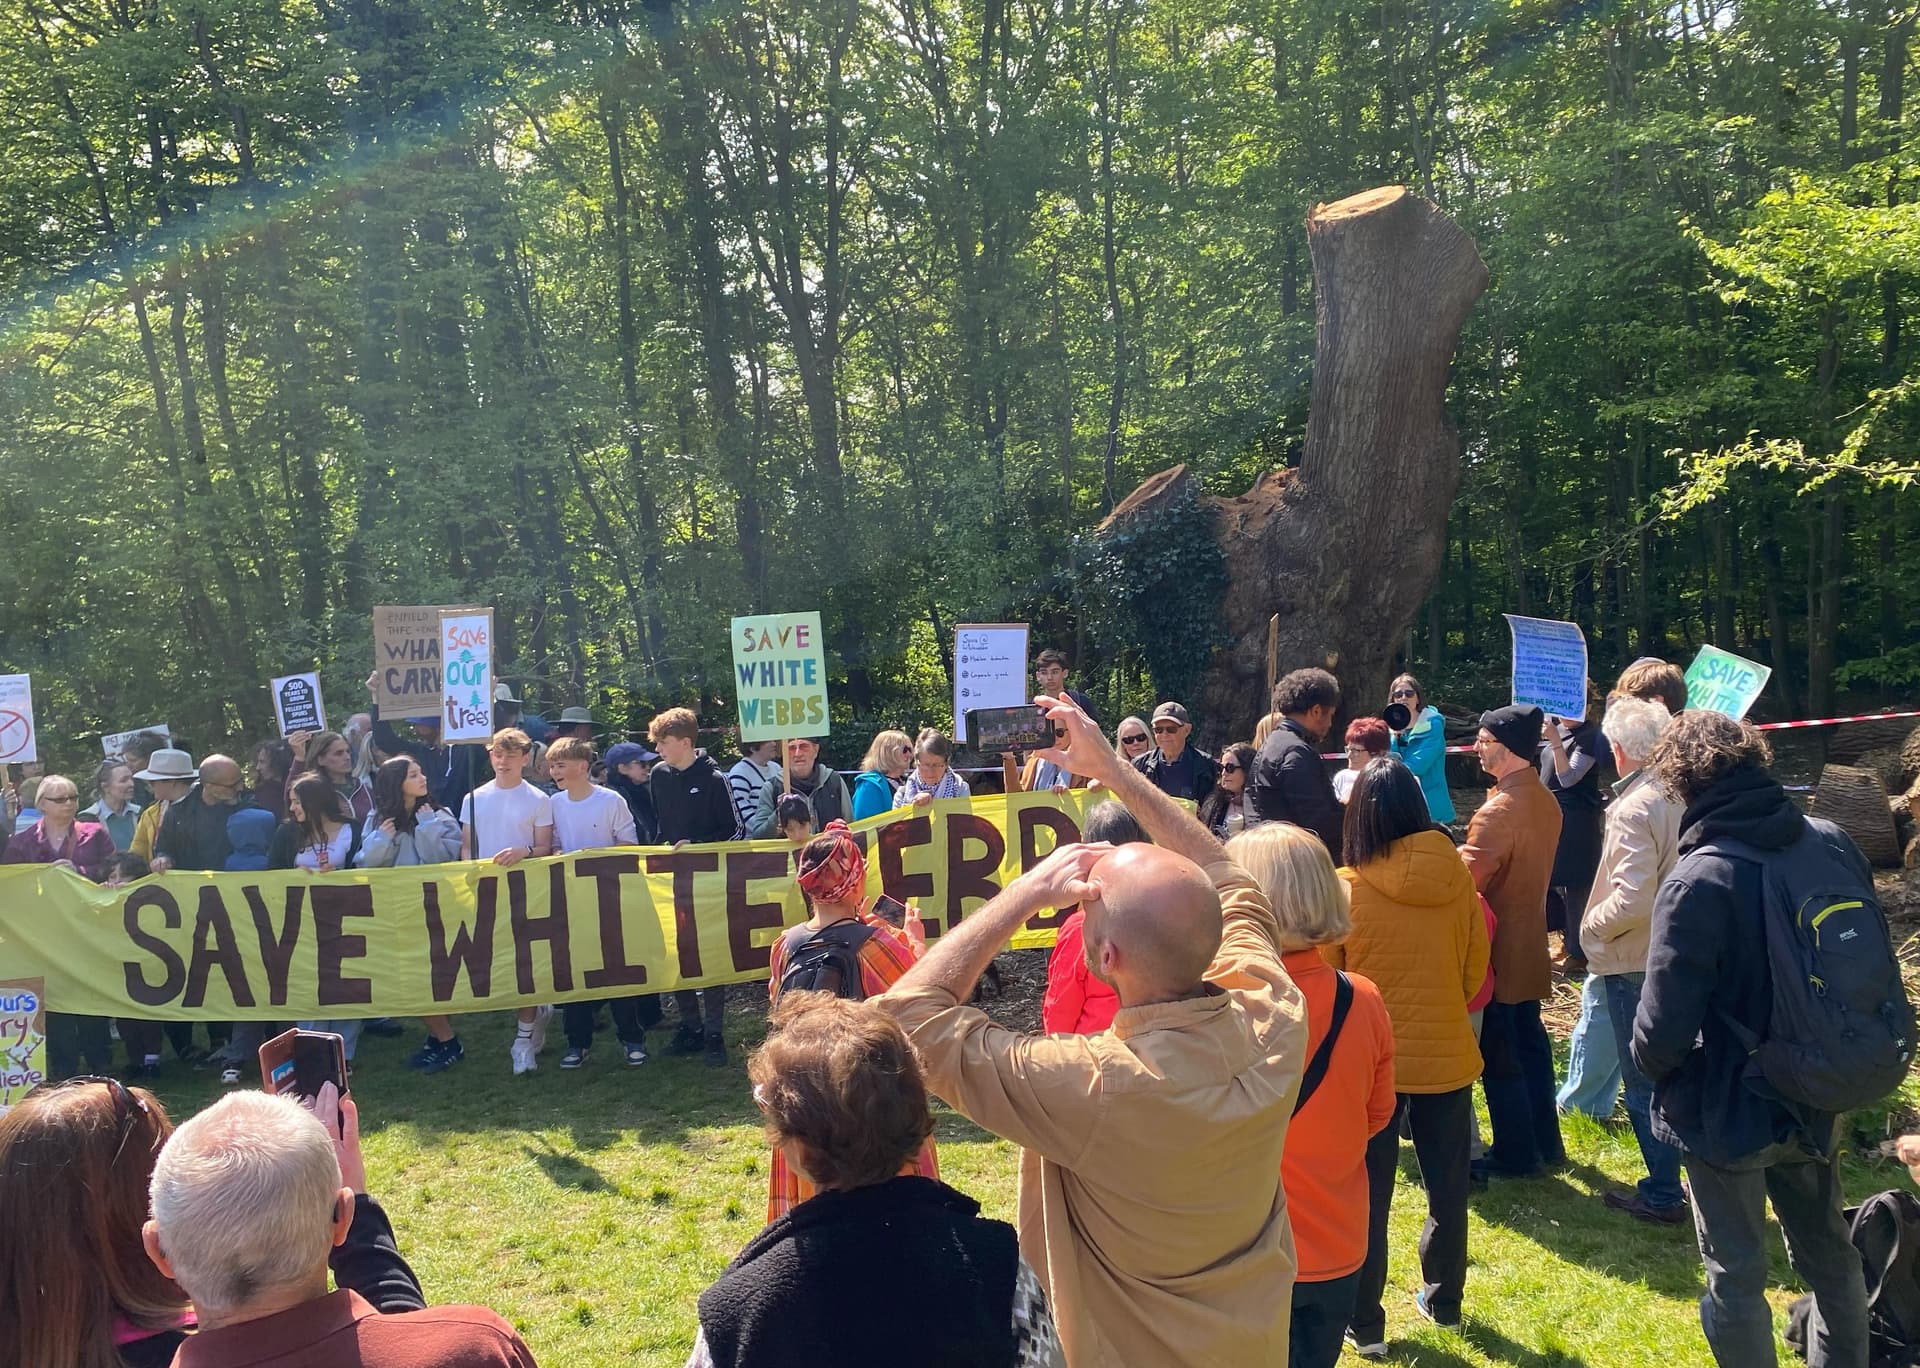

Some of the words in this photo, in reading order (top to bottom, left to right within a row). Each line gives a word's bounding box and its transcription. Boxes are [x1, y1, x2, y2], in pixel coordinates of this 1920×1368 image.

[743, 625, 810, 652] SAVE
[288, 681, 303, 690] 500
[737, 658, 817, 688] WHITE
[1701, 658, 1753, 692] SAVE
[445, 695, 489, 730] trees
[739, 695, 824, 728] WEBBS
[124, 885, 374, 1007] SAVE
